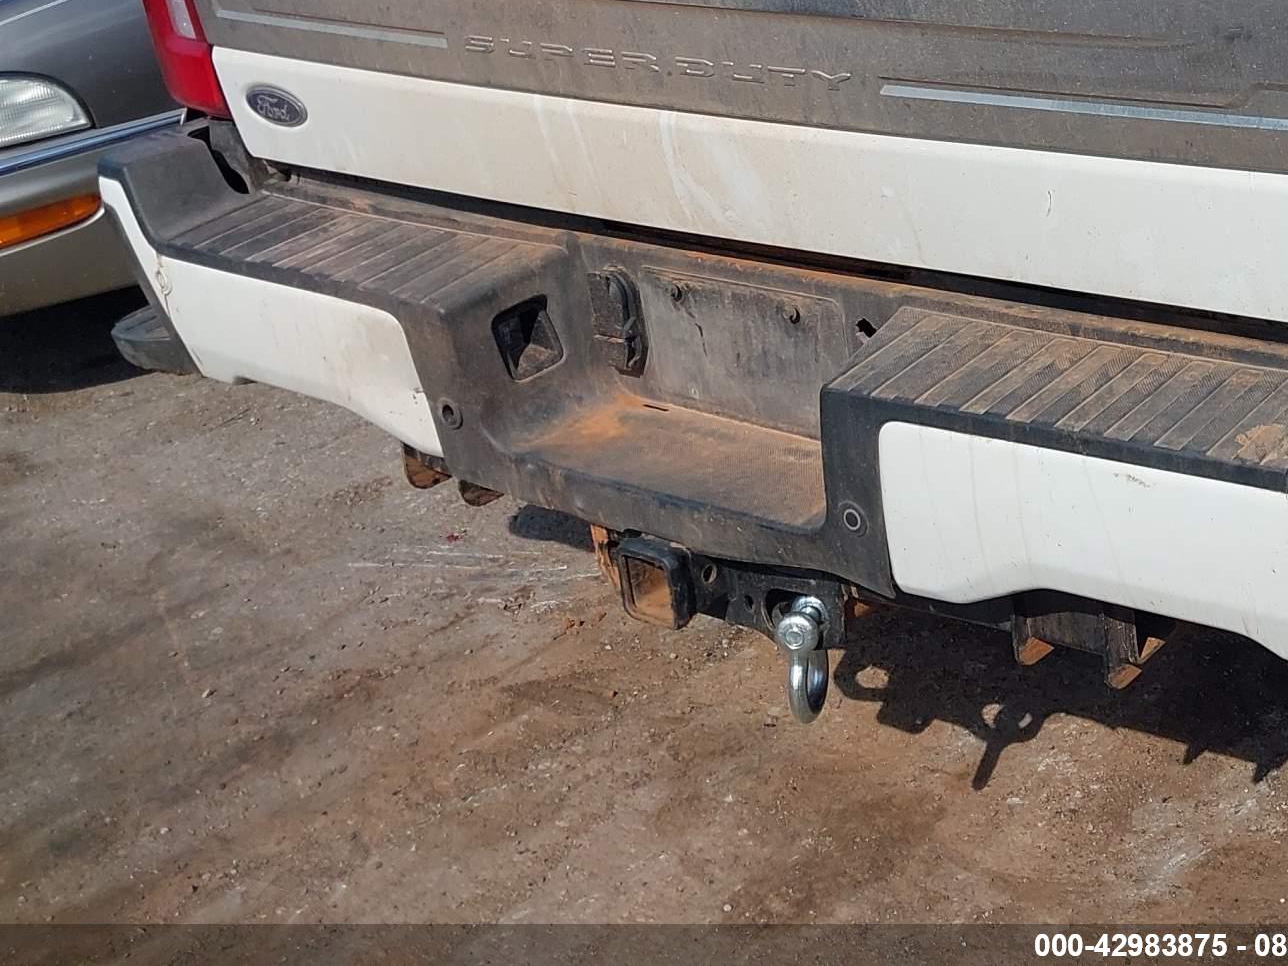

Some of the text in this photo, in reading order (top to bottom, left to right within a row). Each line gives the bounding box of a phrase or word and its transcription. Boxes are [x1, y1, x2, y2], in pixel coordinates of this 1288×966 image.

[464, 34, 853, 92] SUPER DUTY
[256, 94, 290, 121] Ford
